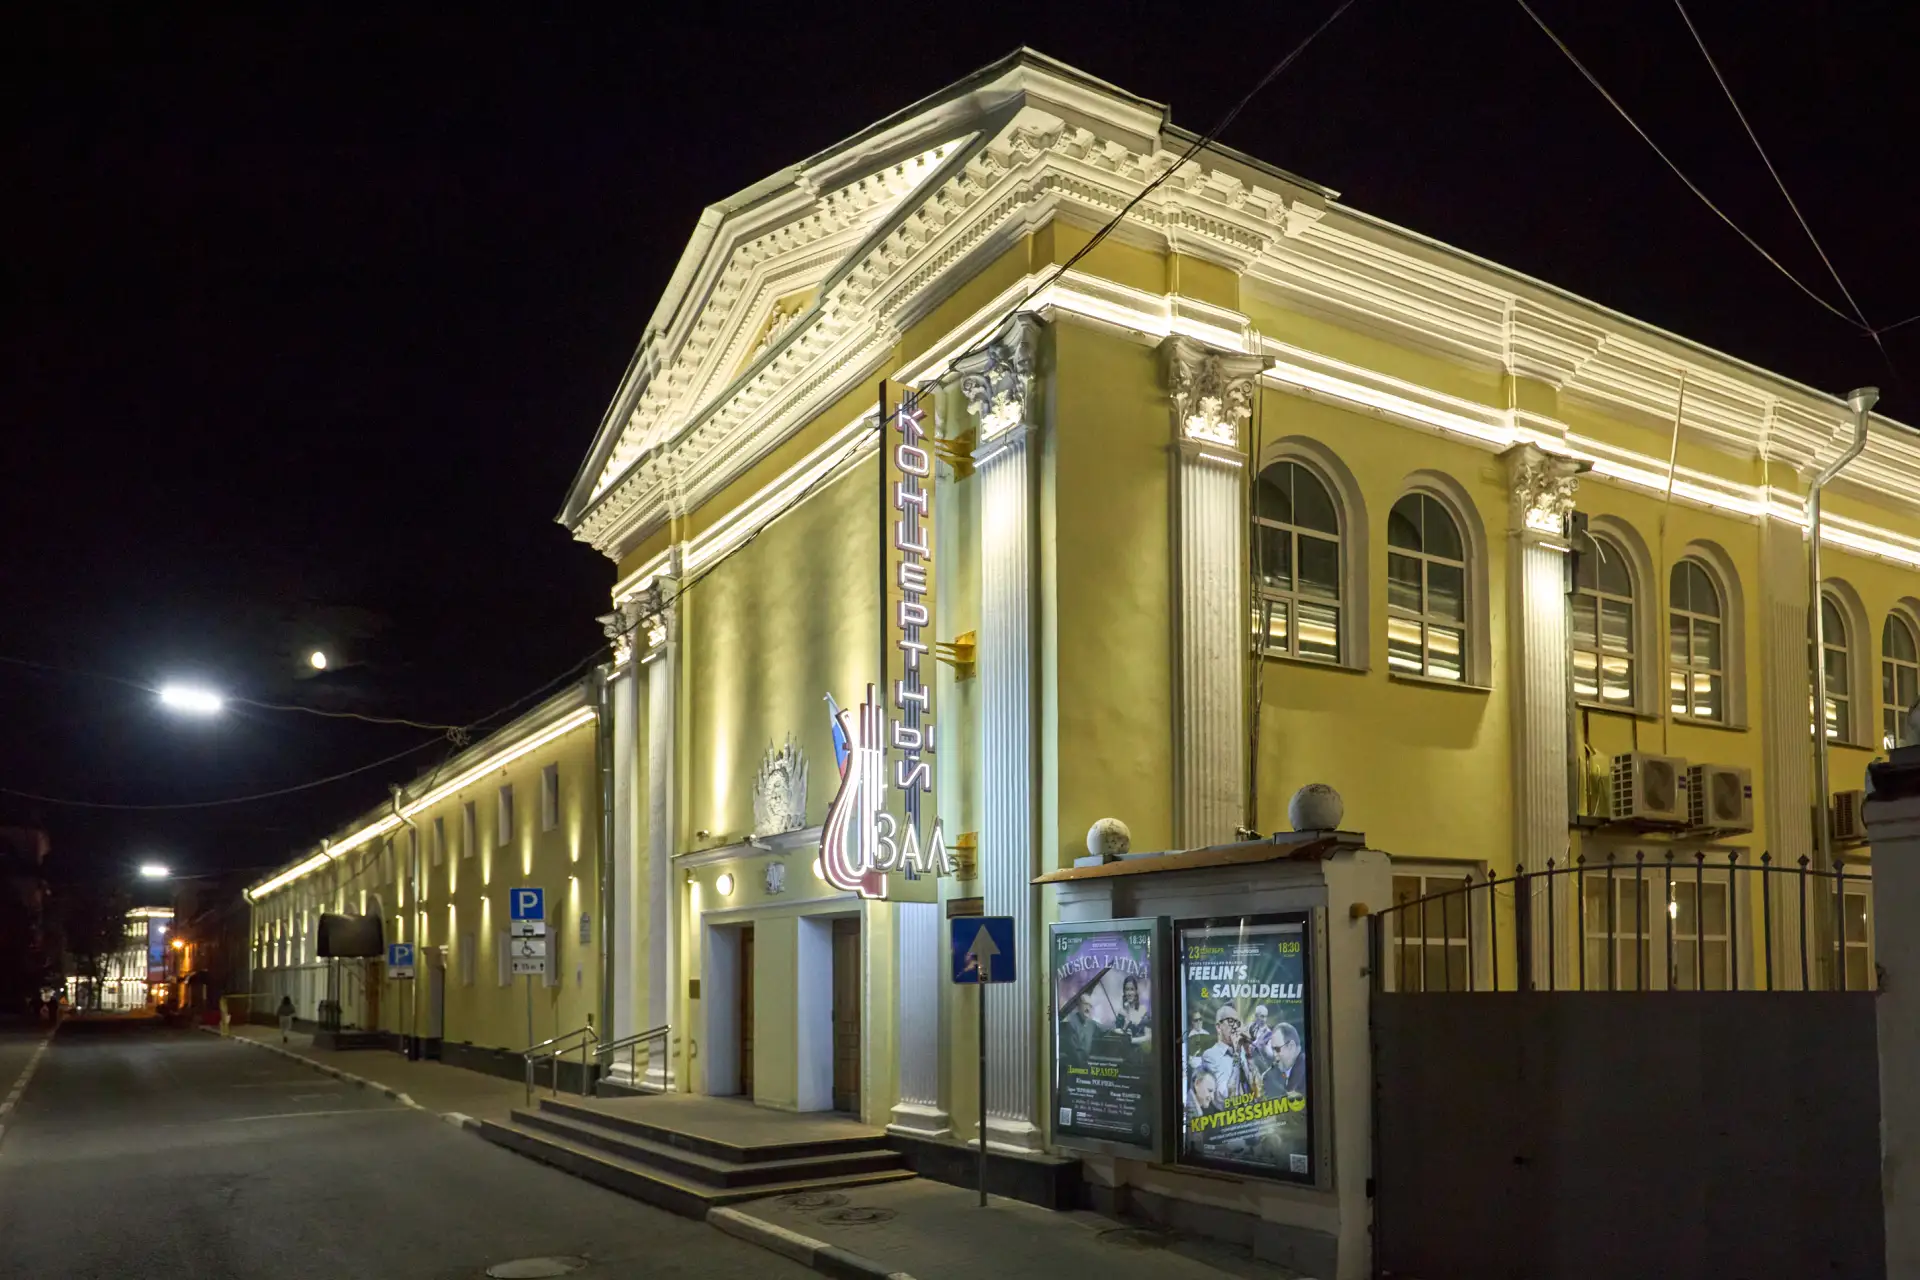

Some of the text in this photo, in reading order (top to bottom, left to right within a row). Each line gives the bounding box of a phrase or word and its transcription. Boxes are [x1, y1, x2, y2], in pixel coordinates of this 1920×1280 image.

[892, 402, 934, 791] КОНЦЕРТНЫЙ
[875, 810, 952, 876] ЗАЛ
[518, 891, 539, 917] P
[1057, 937, 1068, 951] 15
[1129, 935, 1147, 945] 18:30
[1278, 942, 1300, 953] 18:30
[394, 946, 409, 964] P
[1188, 946, 1200, 960] 23
[1056, 954, 1149, 981] MUSICA LATINA
[1188, 964, 1248, 981] FEELIN'S
[1200, 983, 1304, 999] & SAVOLDELLI
[1224, 1092, 1256, 1108] В ШОУ
